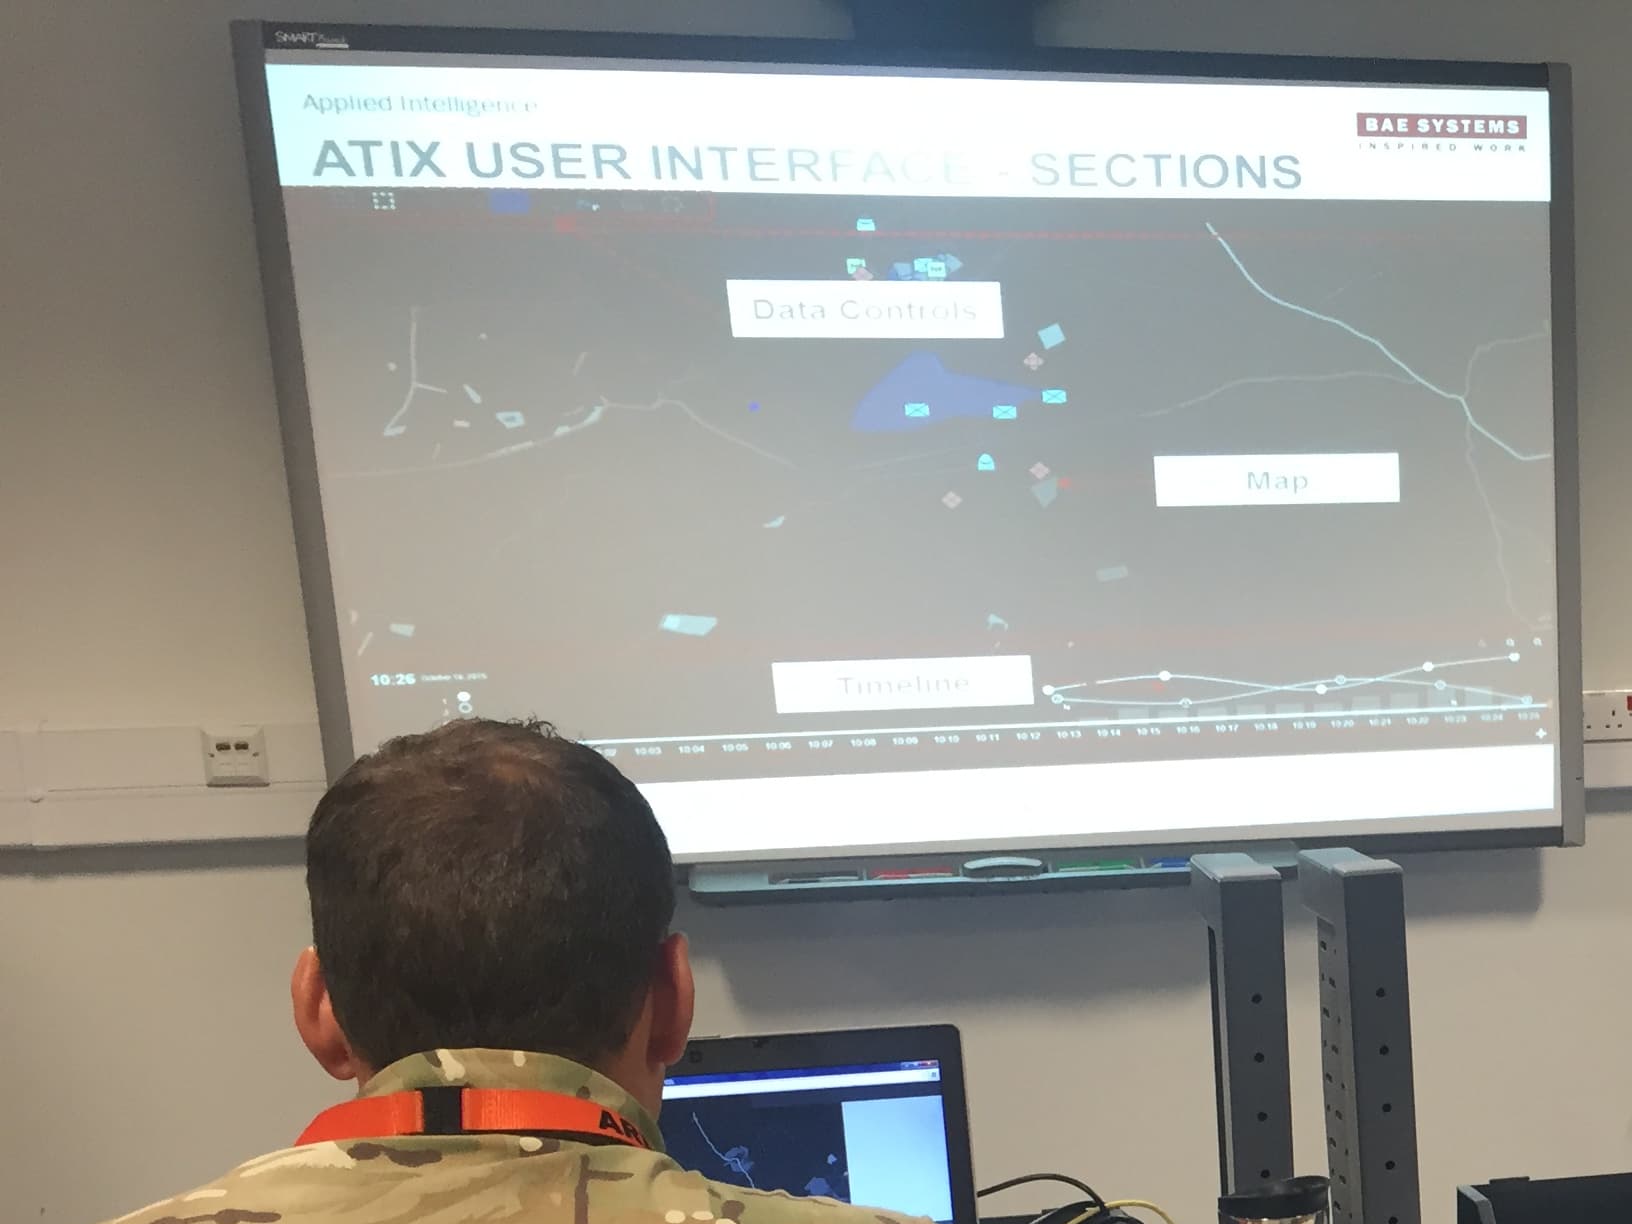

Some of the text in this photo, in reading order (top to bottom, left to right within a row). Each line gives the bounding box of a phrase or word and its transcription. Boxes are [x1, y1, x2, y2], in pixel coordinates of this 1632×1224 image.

[303, 94, 538, 117] Applied Intelligence
[1365, 117, 1520, 134] BAE SYSTEMS
[1358, 142, 1526, 152] INSPIRED WORK
[313, 140, 447, 177] ATIX
[465, 142, 632, 179] USER
[651, 145, 972, 185] INTERFACE
[1031, 153, 1302, 190] SECTIONS
[753, 299, 978, 321] Data Controls
[1246, 471, 1309, 494] Map
[370, 673, 417, 686] 10:26
[836, 675, 970, 695] Timeline
